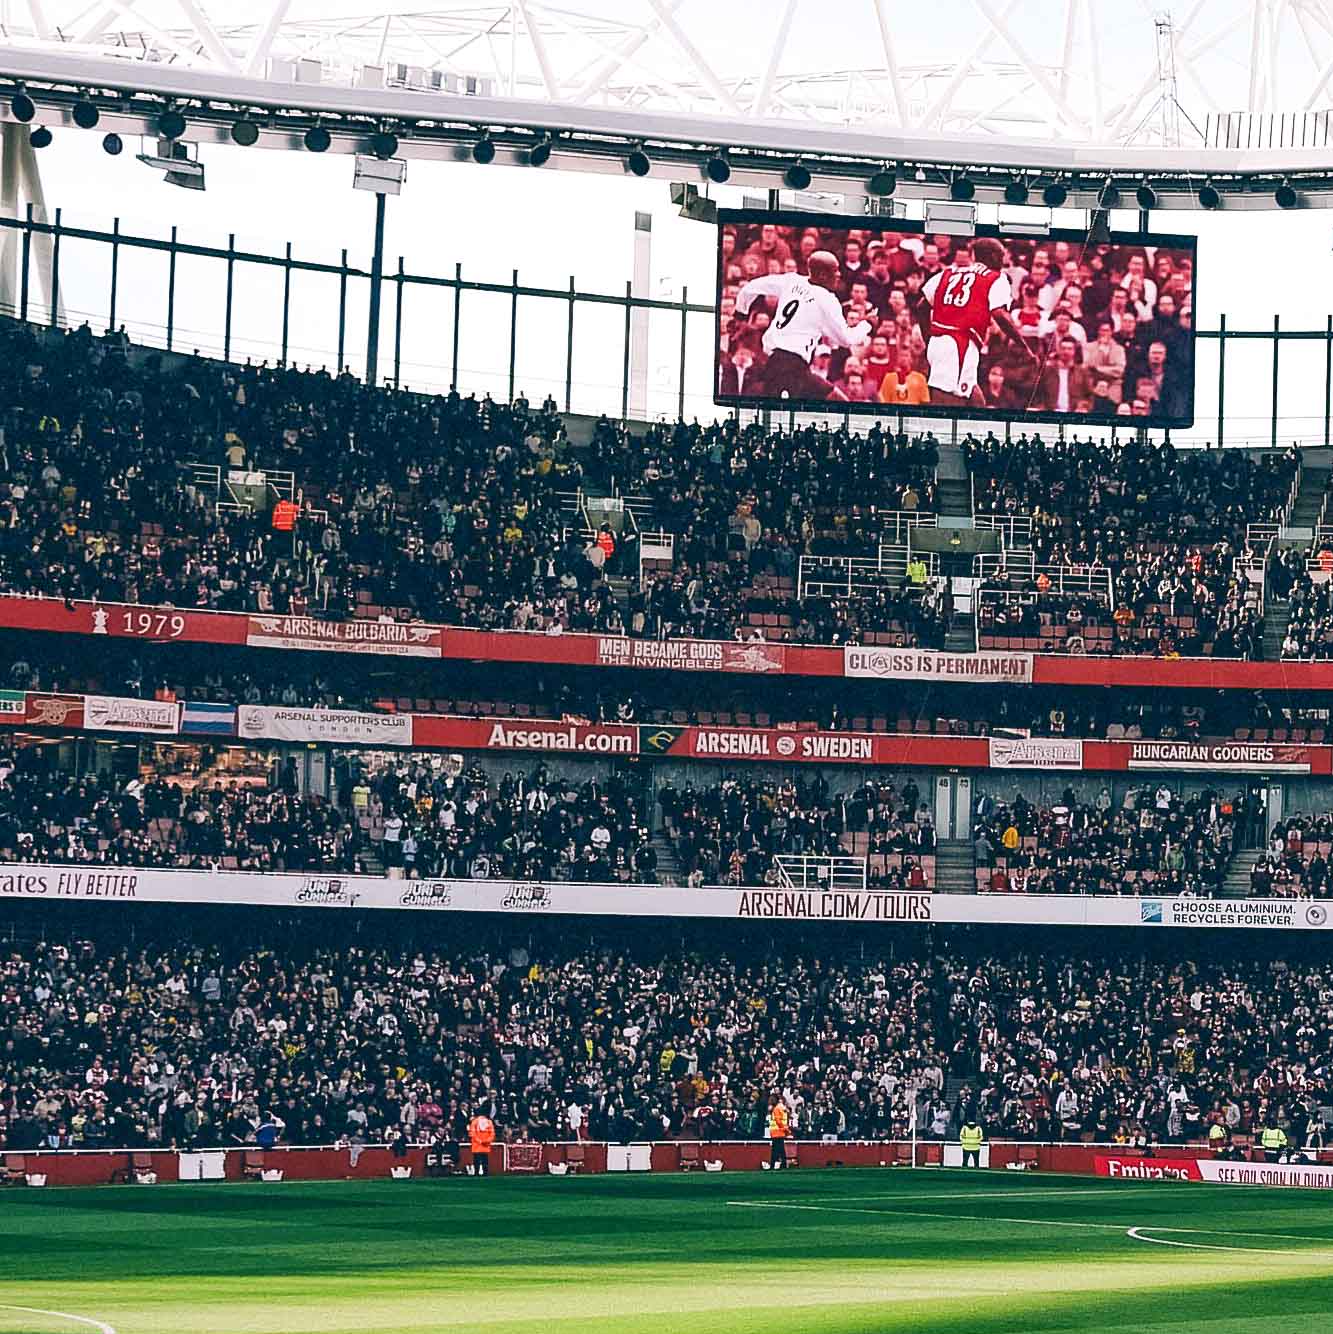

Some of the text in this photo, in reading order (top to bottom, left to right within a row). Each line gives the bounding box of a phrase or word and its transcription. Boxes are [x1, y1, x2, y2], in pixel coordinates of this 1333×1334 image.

[944, 272, 976, 307] 23
[776, 300, 800, 329] 9
[122, 612, 185, 637] 1979
[283, 618, 408, 642] ARSENAL BULGARIA
[600, 639, 722, 660] MEN BECAME GODS
[600, 655, 722, 669] THE INVINCIBLES
[917, 655, 932, 673] IS
[936, 656, 1028, 676] PERMANENT
[274, 711, 405, 727] ARSENAL SUPPORTERS CLUB
[488, 724, 632, 752] Arsenal.com
[696, 732, 872, 759] ARSENAL SWEDEN
[1133, 744, 1274, 761] HUNGARIAN GOONERS
[57, 873, 81, 895] FLY
[86, 874, 137, 896] BETTER
[739, 892, 931, 919] ARSENAL.COM/TOURS
[1172, 902, 1296, 914] CHOOSE ALUMINIUM.
[1173, 914, 1295, 926] RECYCLES FOREVER.
[1218, 1167, 1235, 1183] SEE
[1260, 1170, 1287, 1186] SOON
